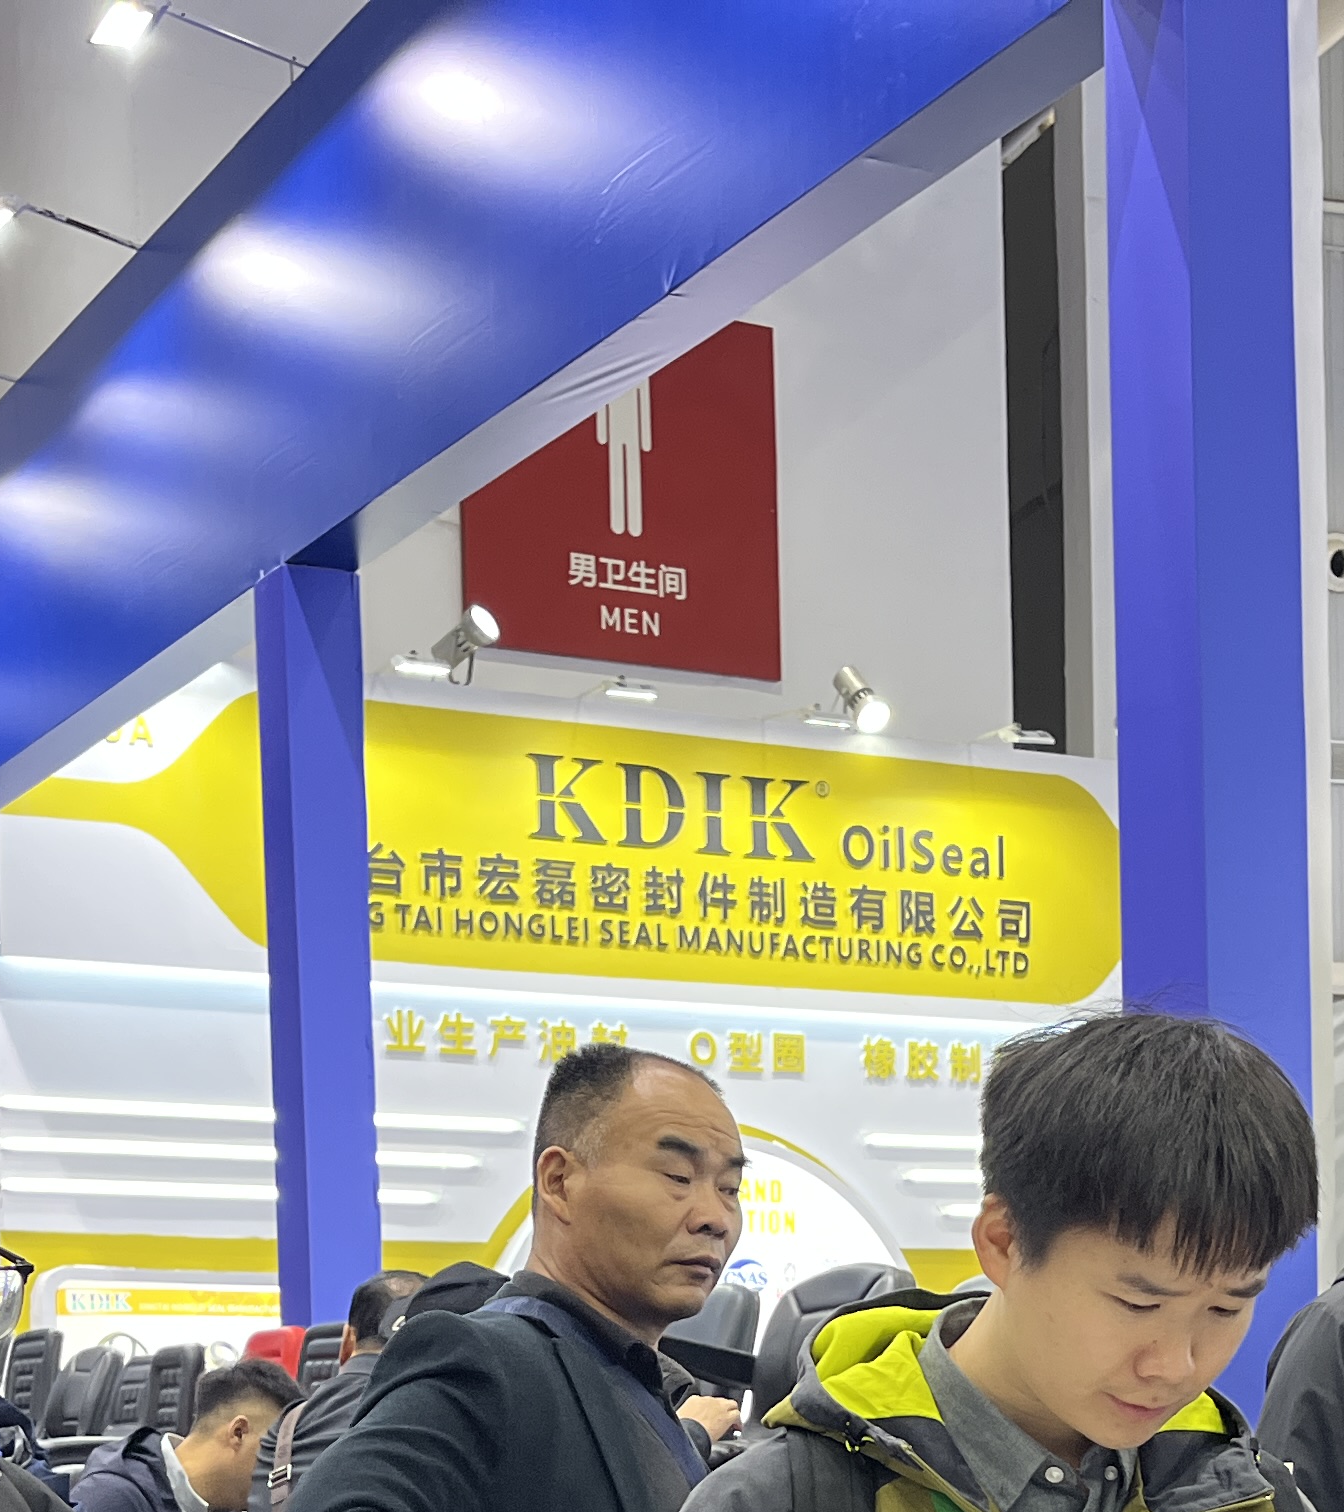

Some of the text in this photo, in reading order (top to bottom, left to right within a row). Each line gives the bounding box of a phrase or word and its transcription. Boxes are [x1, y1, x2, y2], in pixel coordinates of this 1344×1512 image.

[568, 552, 687, 600] 男卫生间
[600, 604, 661, 636] MEN
[527, 752, 1005, 879] KDIK OilSeal
[395, 904, 443, 933] TAI
[455, 909, 590, 943] HONGLEI
[600, 919, 668, 948] SEAL
[677, 925, 923, 968] MANUFACTURING
[862, 1035, 983, 1085] 橡胶制
